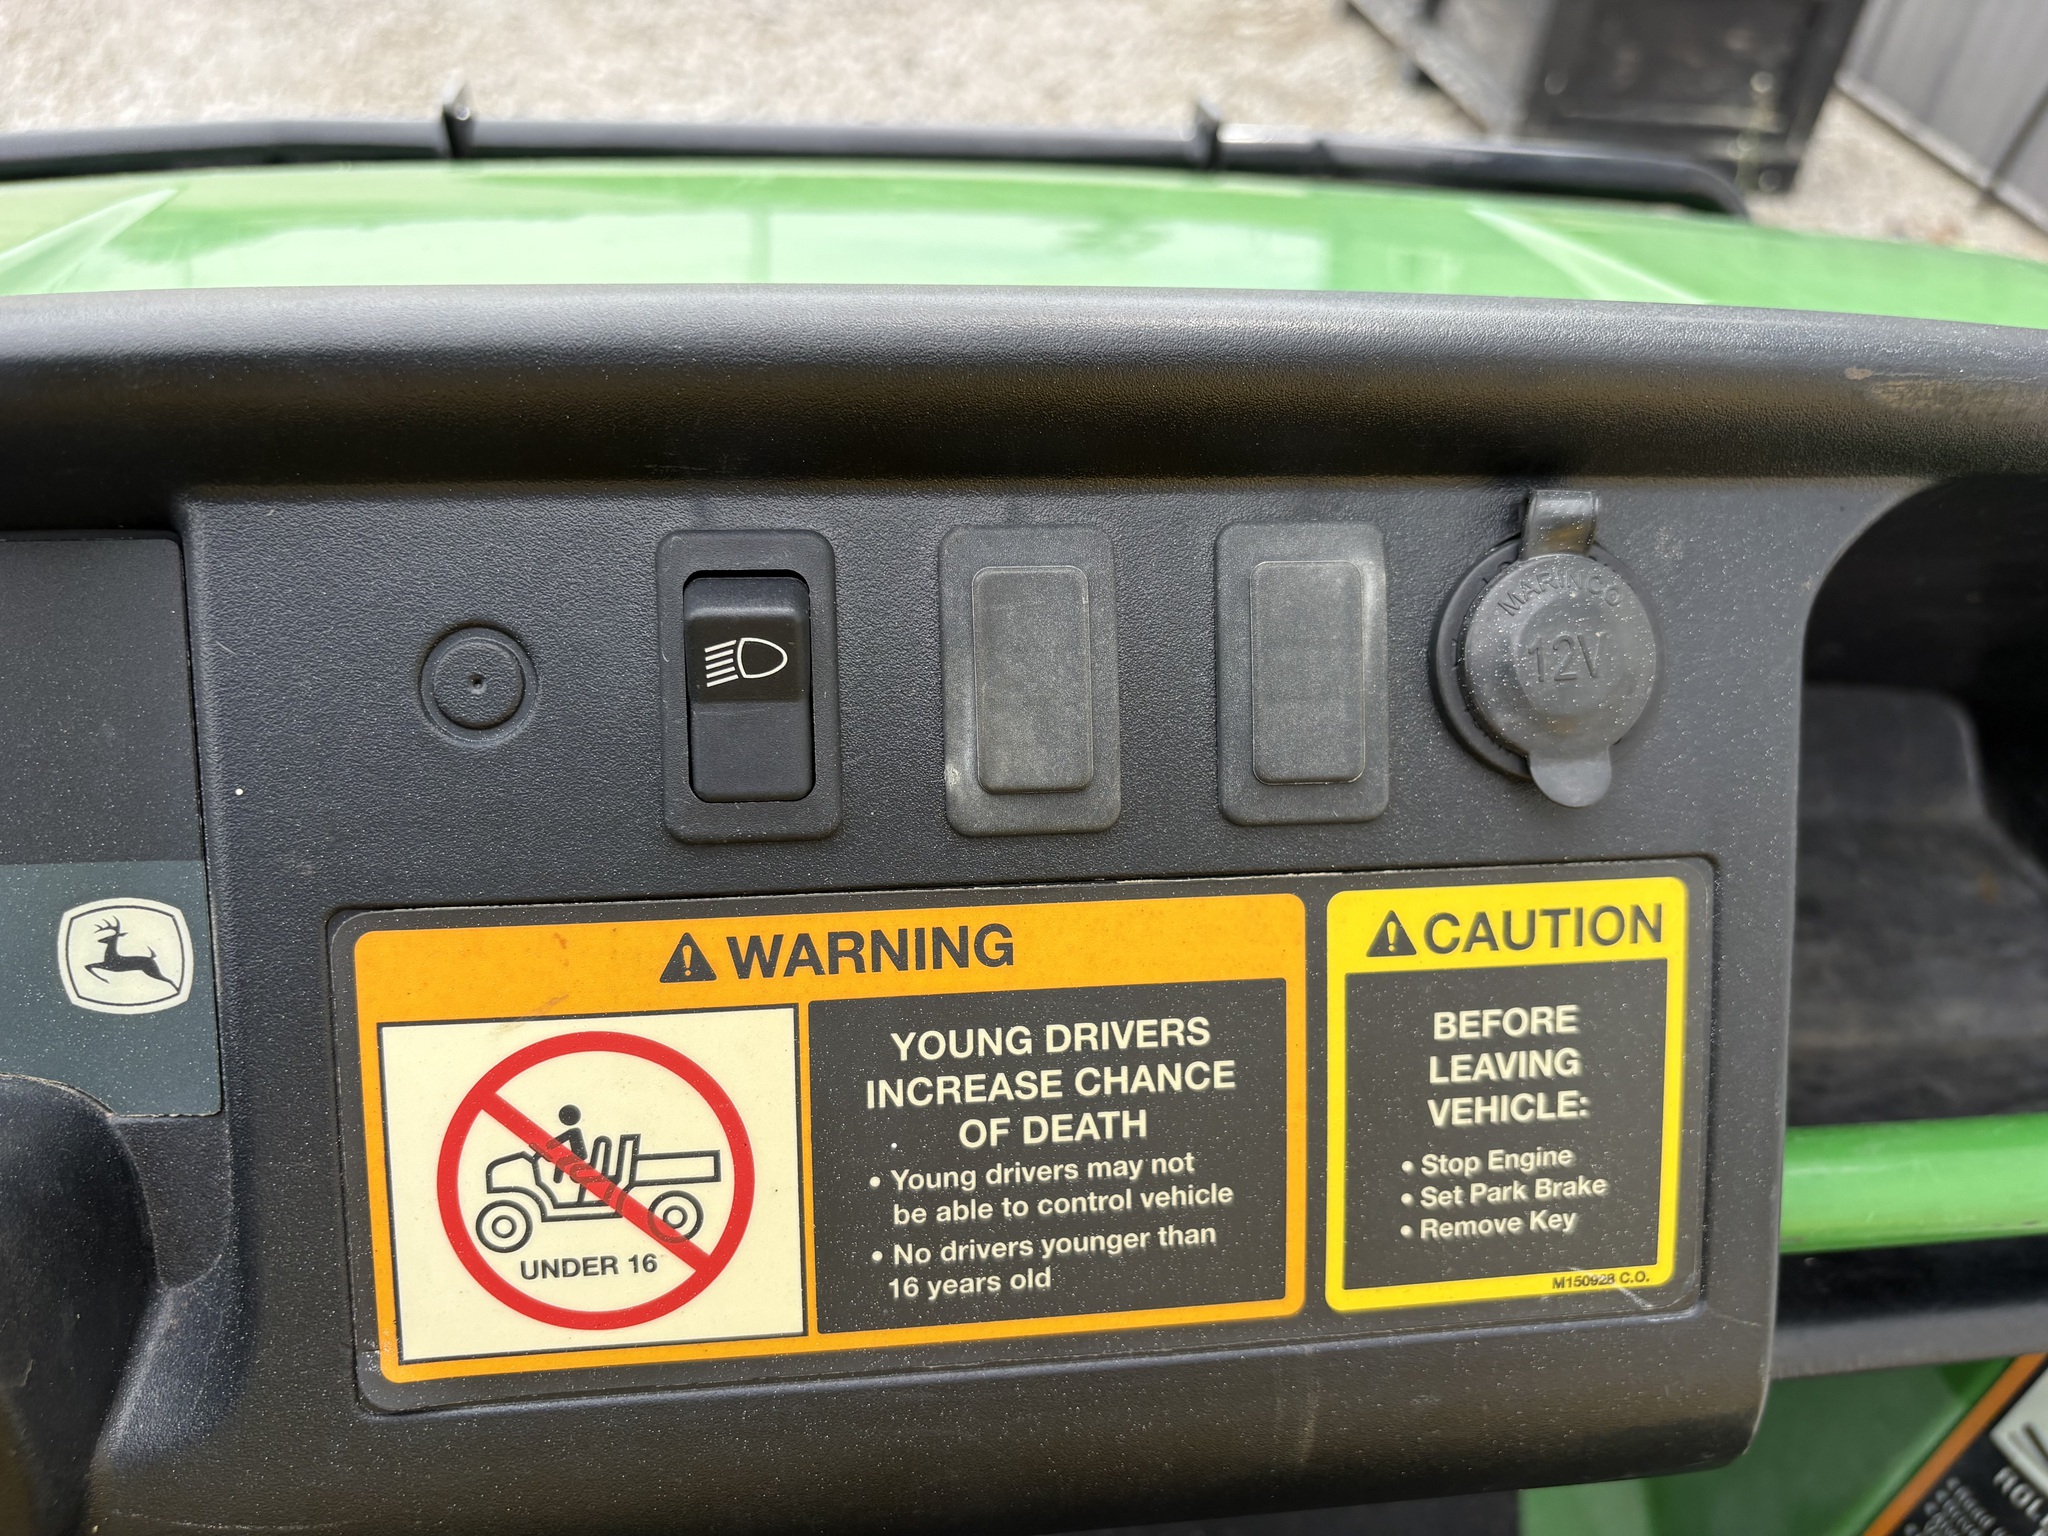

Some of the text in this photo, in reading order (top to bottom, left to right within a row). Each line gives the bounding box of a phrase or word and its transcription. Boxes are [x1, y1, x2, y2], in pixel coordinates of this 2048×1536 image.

[1497, 570, 1621, 616] MARINCO
[1527, 632, 1607, 683] 12V
[1423, 903, 1663, 955] CAUTION
[726, 920, 1014, 979] WARNING
[891, 1017, 1210, 1060] YOUNG DRIVERS
[1434, 1005, 1581, 1041] BEFORE
[1430, 1048, 1582, 1083] LEAVING
[867, 1061, 1235, 1109] INCREASE CHANCE
[1428, 1091, 1591, 1127] VEHICLE:
[960, 1110, 1147, 1148] OF DEATH
[891, 1153, 1194, 1192] Young drivers may not
[1421, 1146, 1574, 1177] Stop Engine
[894, 1184, 1233, 1225] be able to control vehicle
[1420, 1175, 1608, 1207] Set Park Brake
[1420, 1211, 1577, 1240] Remove Key
[893, 1225, 1216, 1265] No drivers younger than
[520, 1253, 658, 1280] UNDER 16
[889, 1268, 1051, 1300] 16 years old
[1619, 1270, 1650, 1284] C.O.
